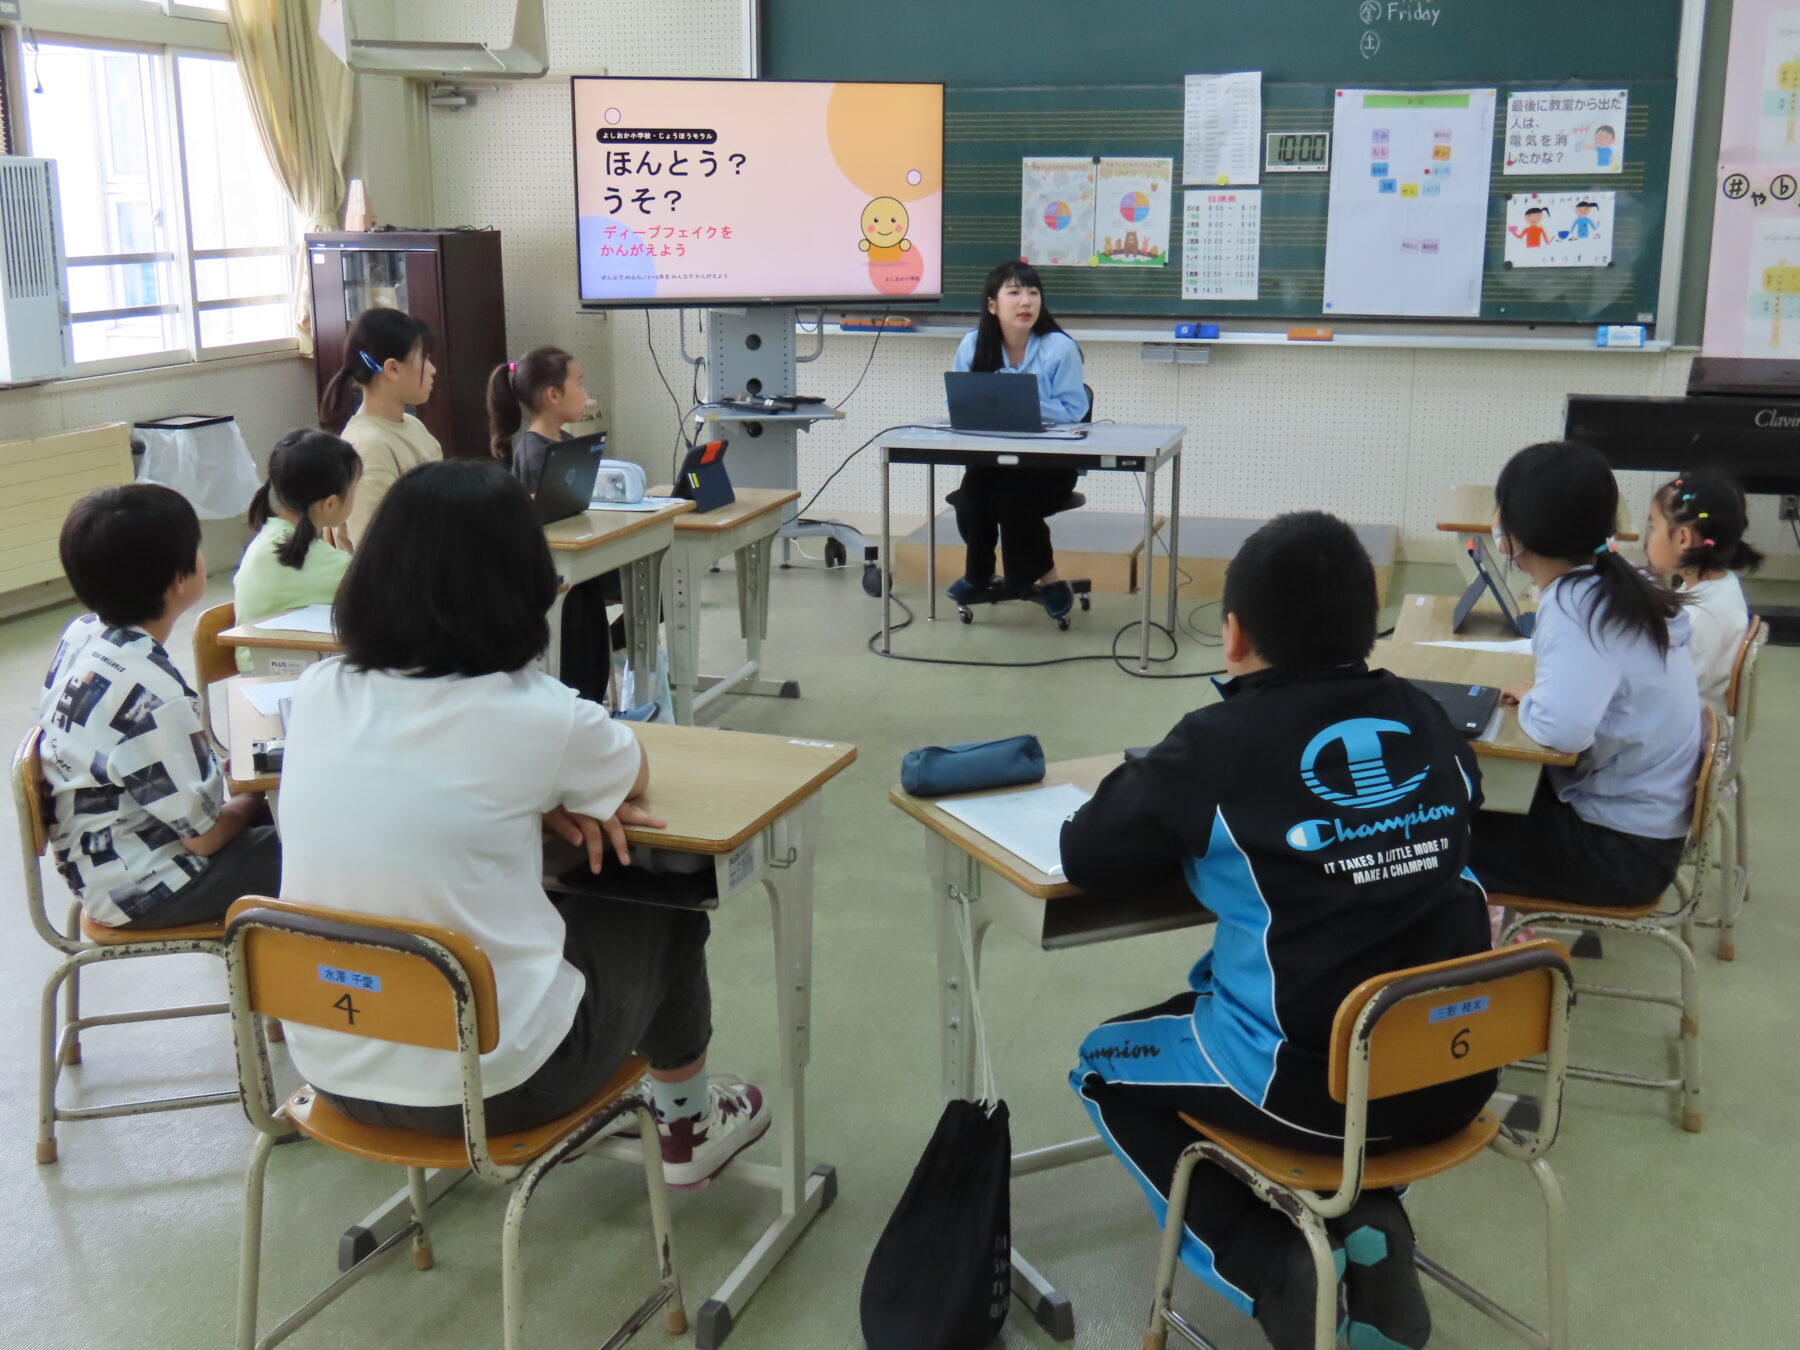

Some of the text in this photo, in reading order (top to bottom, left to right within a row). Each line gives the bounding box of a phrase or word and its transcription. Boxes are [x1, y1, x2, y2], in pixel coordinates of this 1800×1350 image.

[1388, 2, 1440, 26] Friday
[1511, 98, 1622, 112] 最後に教室から出た
[1510, 118, 1540, 129] 人は、
[1278, 135, 1326, 161] 10:00
[1509, 134, 1568, 147] 電気を消
[606, 150, 746, 178] ほんとう？
[604, 187, 682, 215] うそ？
[601, 244, 686, 257] かんがえよう
[1286, 803, 1456, 851] Champion
[1324, 837, 1449, 874] IT TAKES A LITTLE MORE TO
[1352, 856, 1438, 885] MAKE A CHAMPION
[333, 993, 360, 1025] 4
[1451, 1028, 1470, 1059] 6
